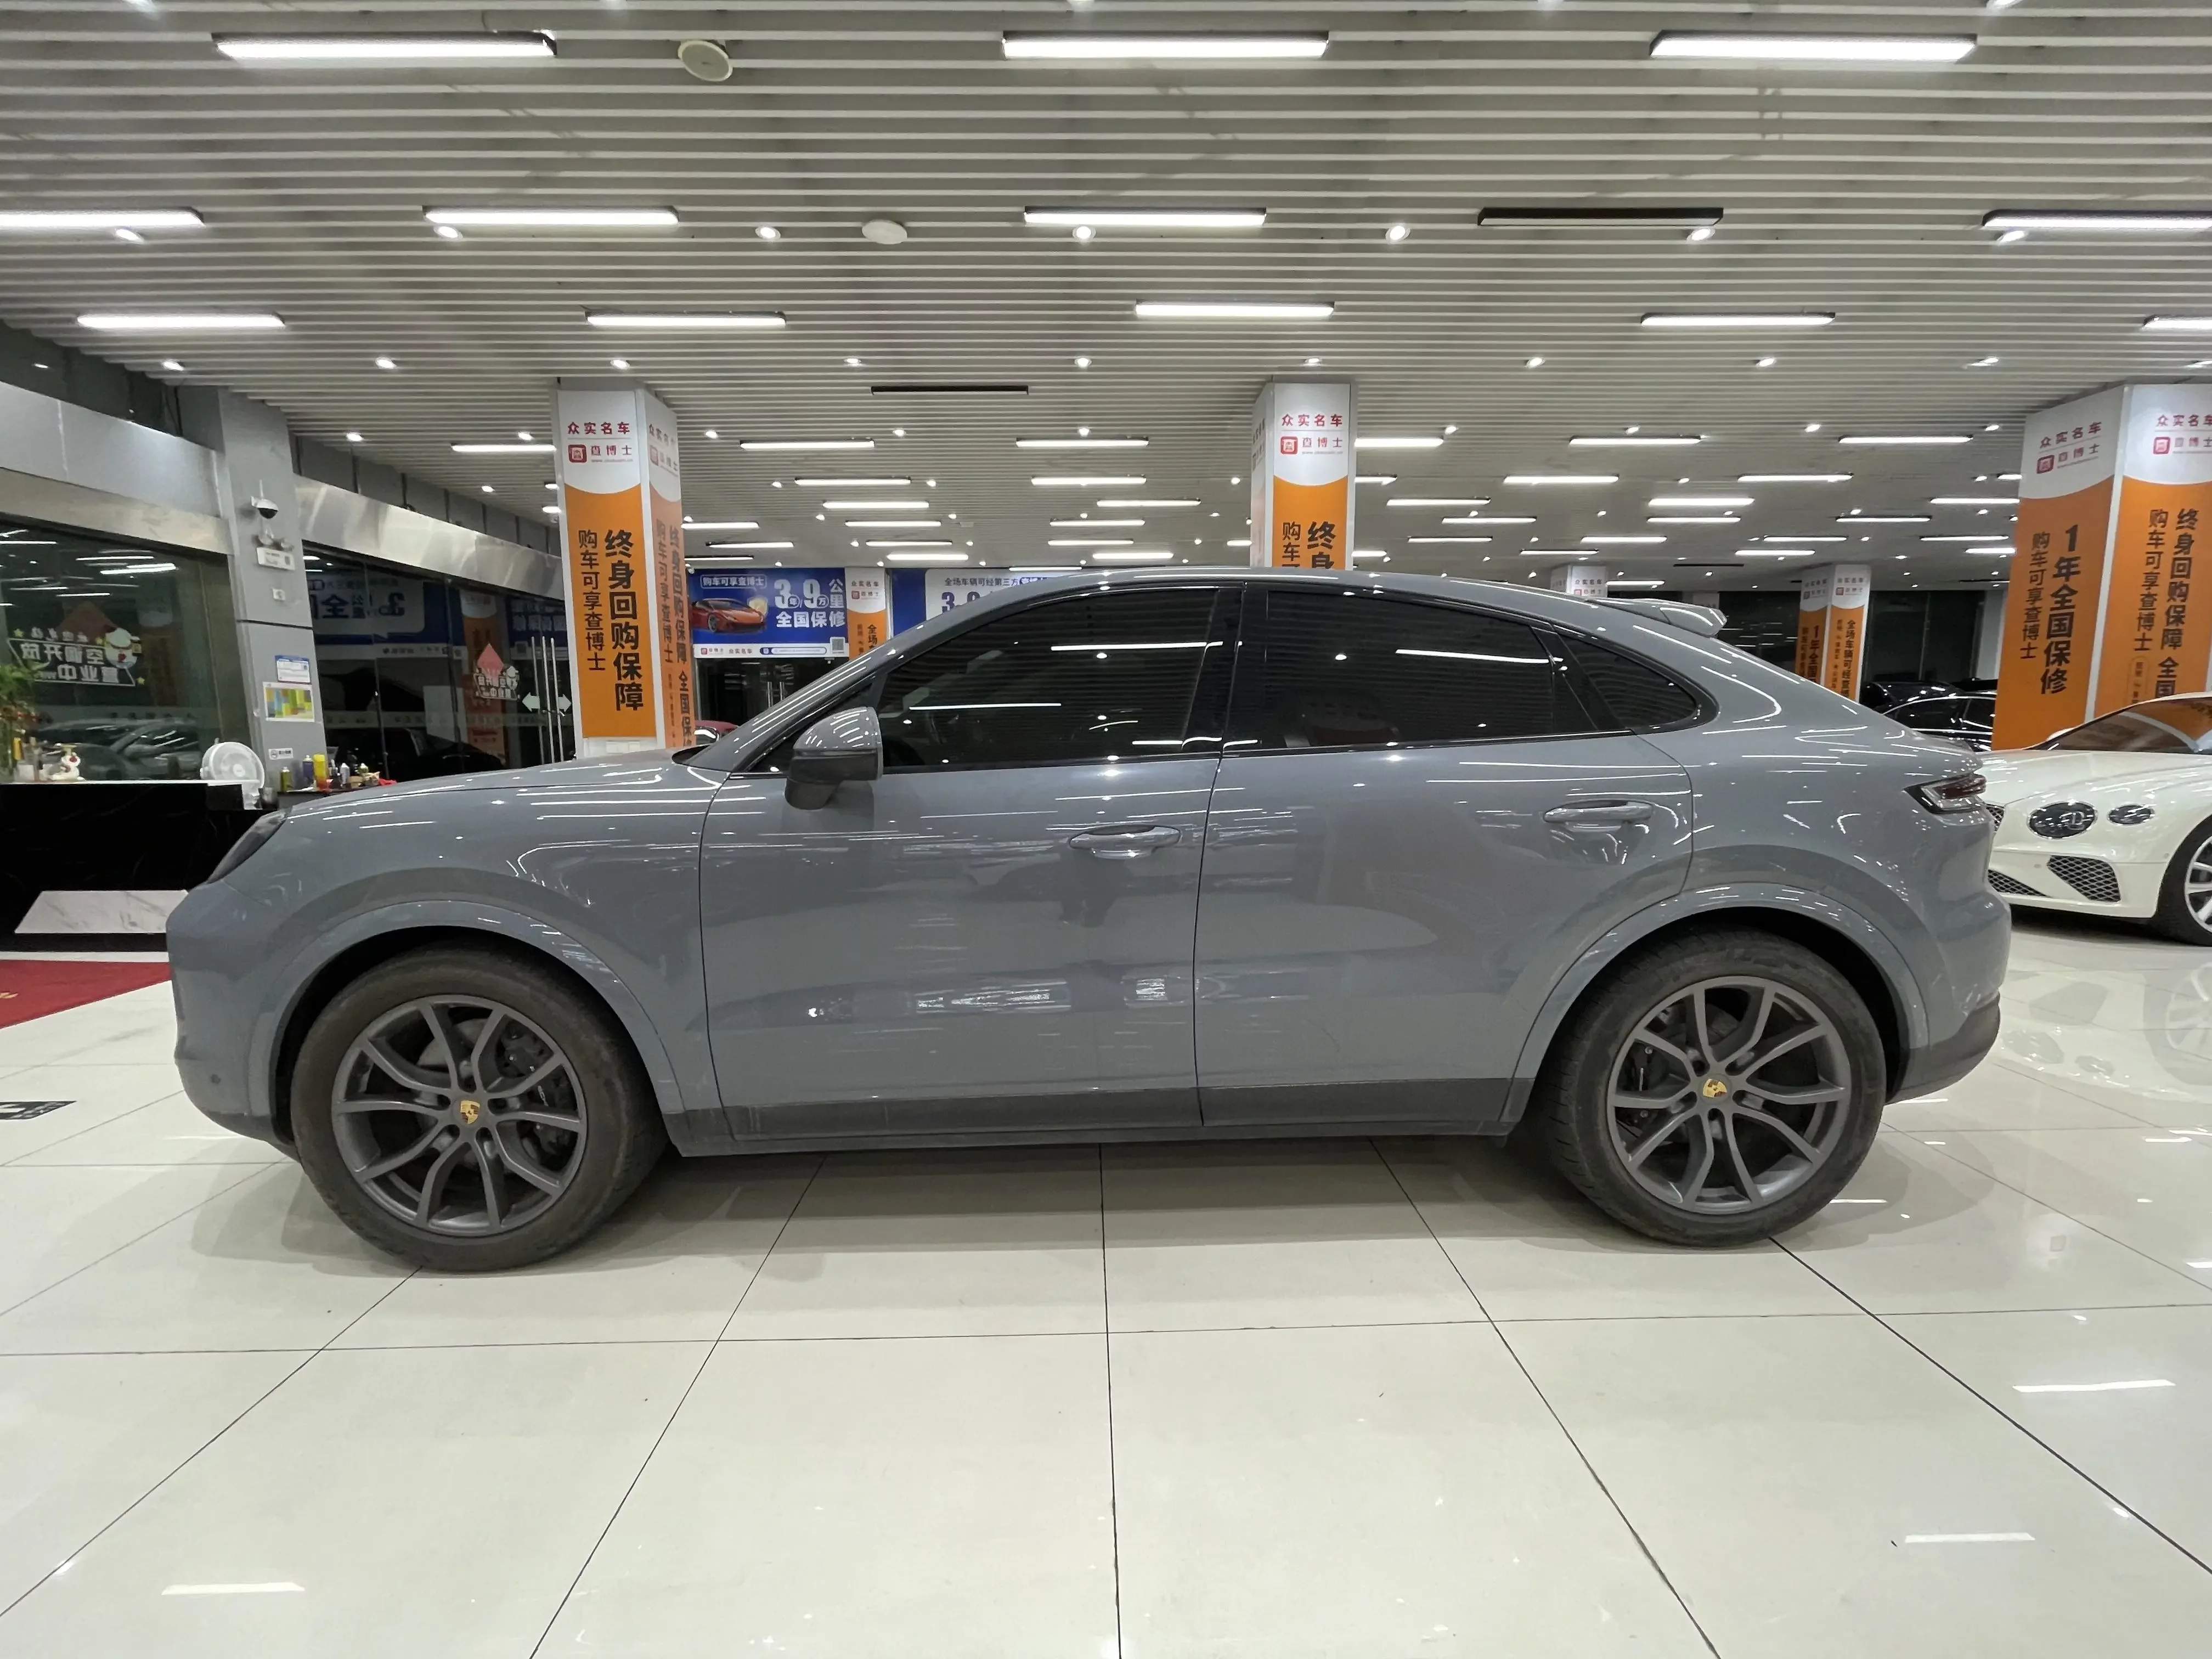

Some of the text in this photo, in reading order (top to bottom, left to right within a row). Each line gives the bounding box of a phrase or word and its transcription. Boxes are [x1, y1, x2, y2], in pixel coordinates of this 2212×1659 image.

[567, 421, 631, 435] 众实名车
[1282, 413, 1343, 427] 众实名车
[1302, 437, 1343, 449] 查博士
[2040, 421, 2102, 449] 众实名车
[1282, 521, 1302, 568] 购车
[2134, 509, 2169, 652] 购车可享查博士
[2160, 508, 2199, 651] 终身回购保障
[577, 529, 606, 672] 购车可享查博士
[604, 529, 644, 712] 终身回购保障
[776, 611, 845, 628] 全国保修
[2019, 531, 2051, 660] 购车可享查博士
[2040, 524, 2082, 695] 1年全国保修
